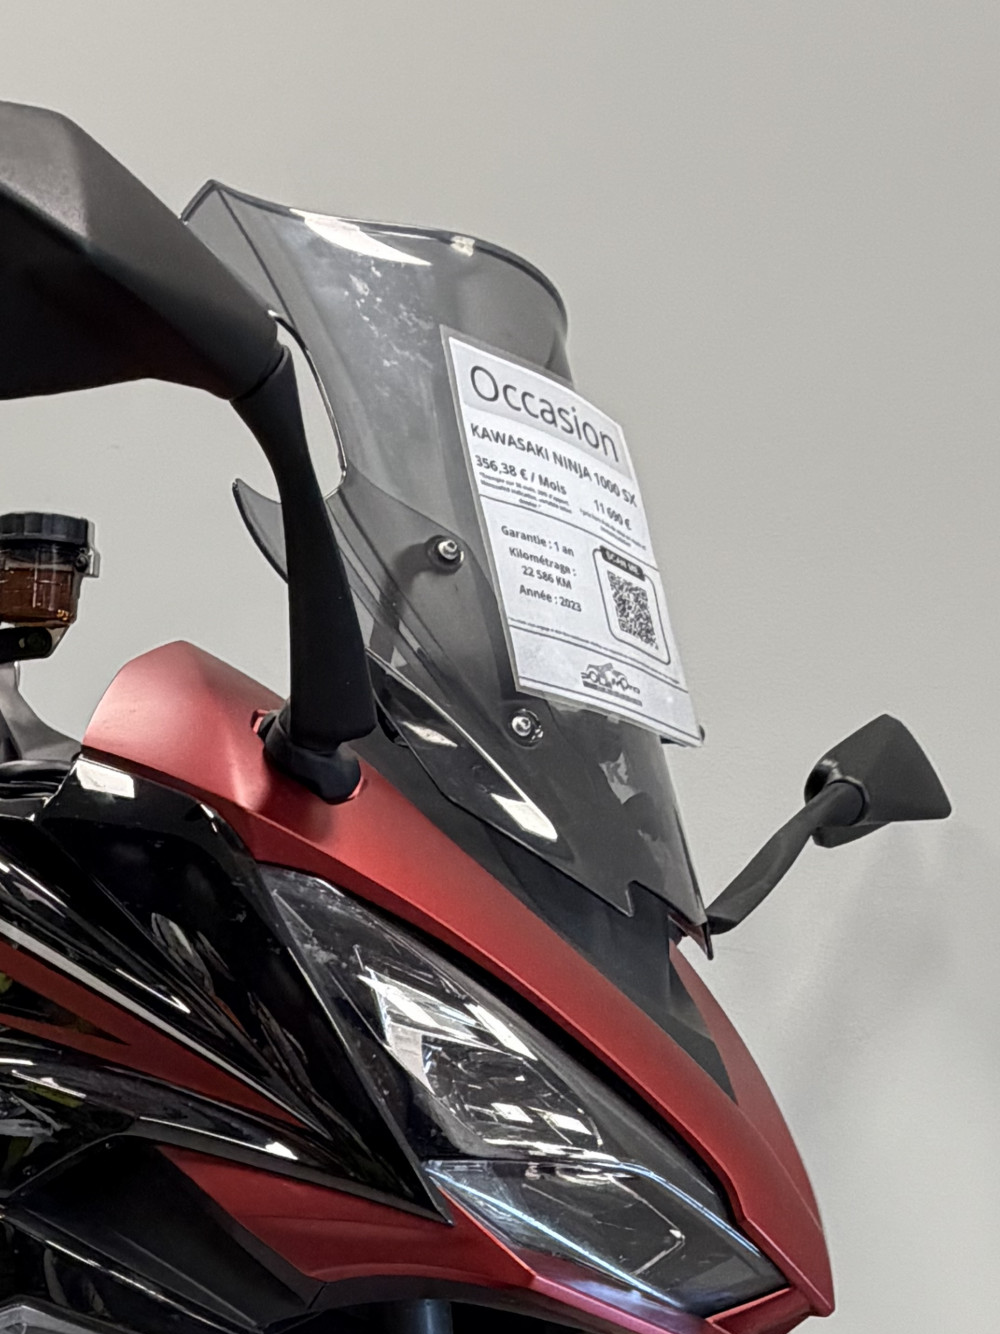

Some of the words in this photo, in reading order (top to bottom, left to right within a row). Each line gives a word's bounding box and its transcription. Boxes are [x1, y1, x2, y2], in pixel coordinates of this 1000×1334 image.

[470, 365, 619, 463] Occasion
[470, 423, 549, 461] KAWASAKI
[552, 451, 592, 482] NINJA
[593, 472, 621, 498] 1000
[621, 488, 638, 507] SX
[475, 455, 517, 477] 356,38
[520, 468, 529, 481] €
[538, 474, 567, 496] Mois
[501, 525, 547, 547] Garantie
[553, 541, 560, 552] 1
[561, 546, 575, 557] an
[521, 565, 535, 578] 22
[555, 576, 572, 590] KM
[519, 584, 553, 603] Année
[558, 596, 582, 613] 2023
